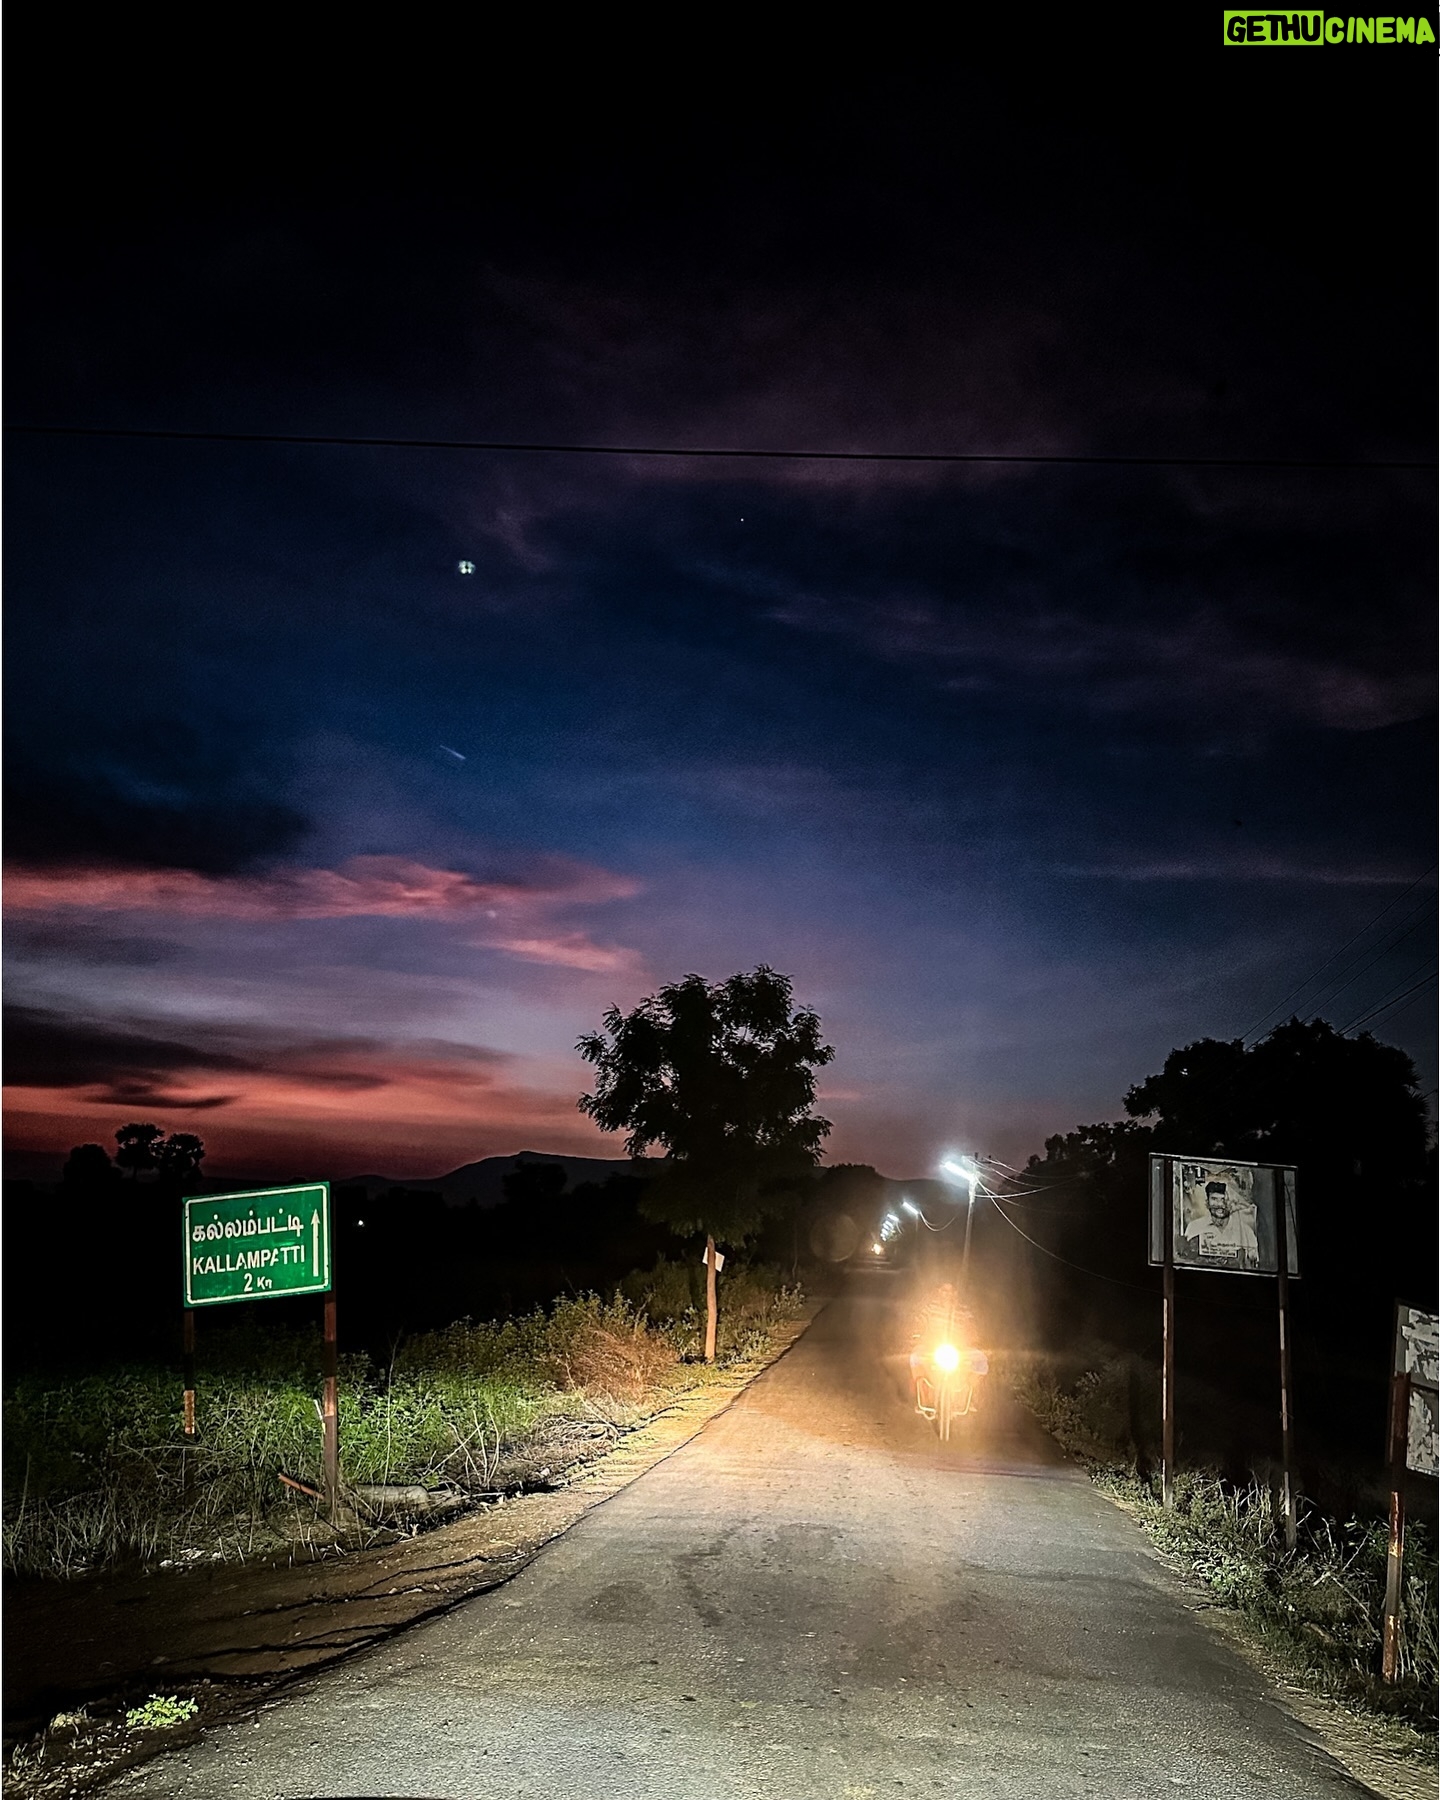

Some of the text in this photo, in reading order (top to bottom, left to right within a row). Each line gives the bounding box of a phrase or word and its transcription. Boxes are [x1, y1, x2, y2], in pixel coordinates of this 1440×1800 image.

[192, 1207, 304, 1242] கல்லம்பட்டி
[193, 1244, 305, 1276] KALLAMPATTI
[243, 1272, 253, 1292] 2
